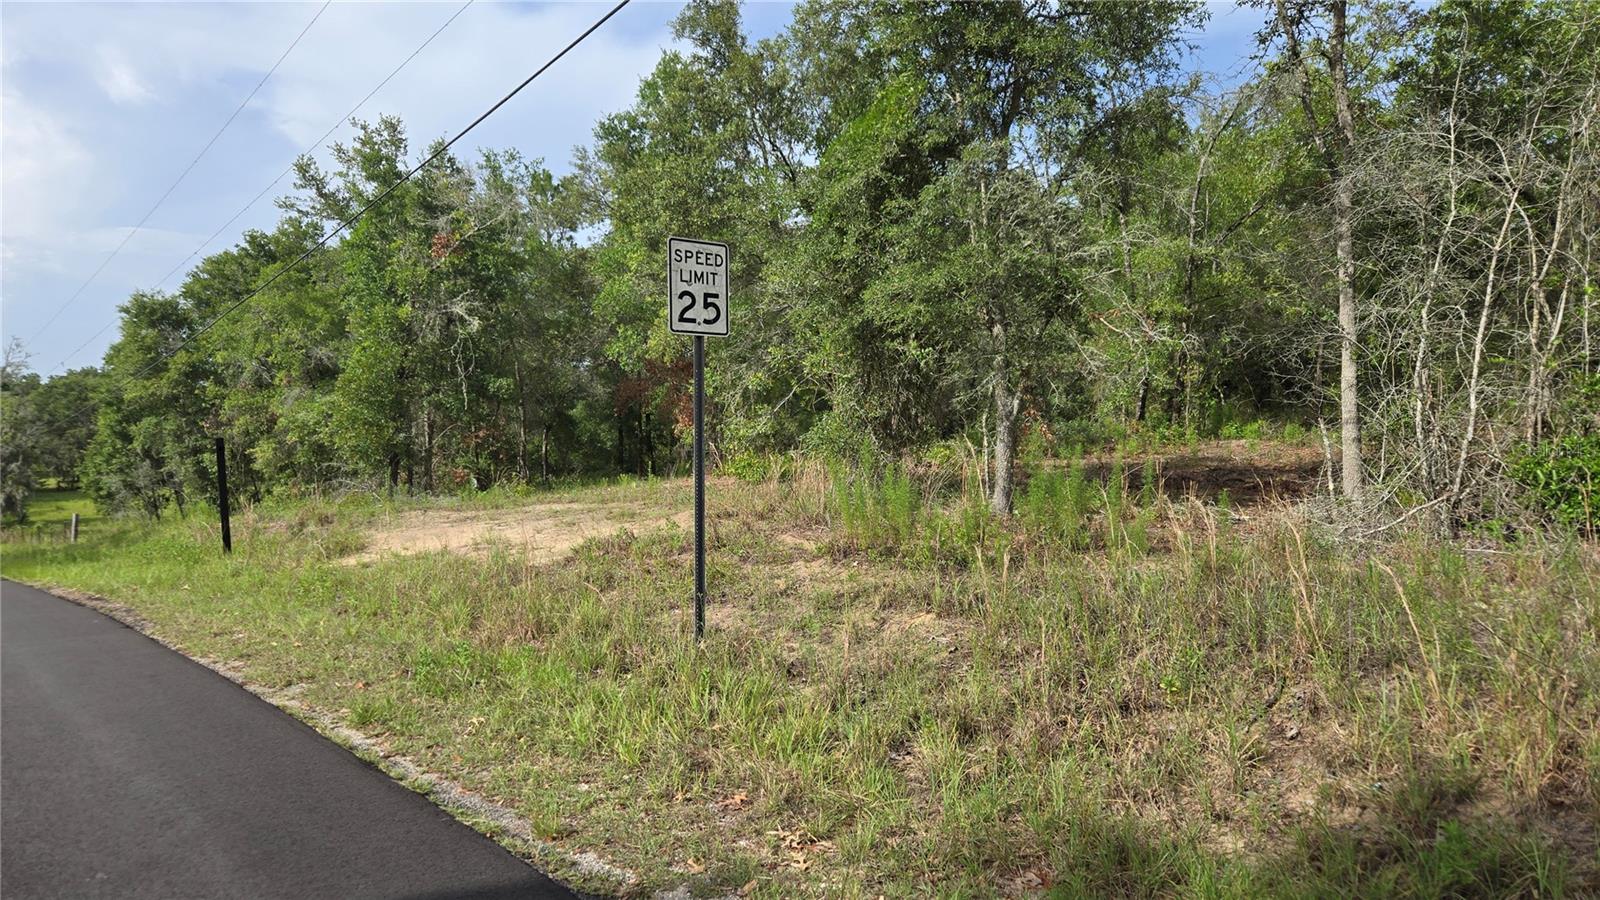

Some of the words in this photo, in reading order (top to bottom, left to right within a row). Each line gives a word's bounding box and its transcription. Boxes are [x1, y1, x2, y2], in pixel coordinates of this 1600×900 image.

[674, 249, 723, 267] SPEED
[680, 269, 718, 285] LIMIT
[678, 290, 721, 325] 25
